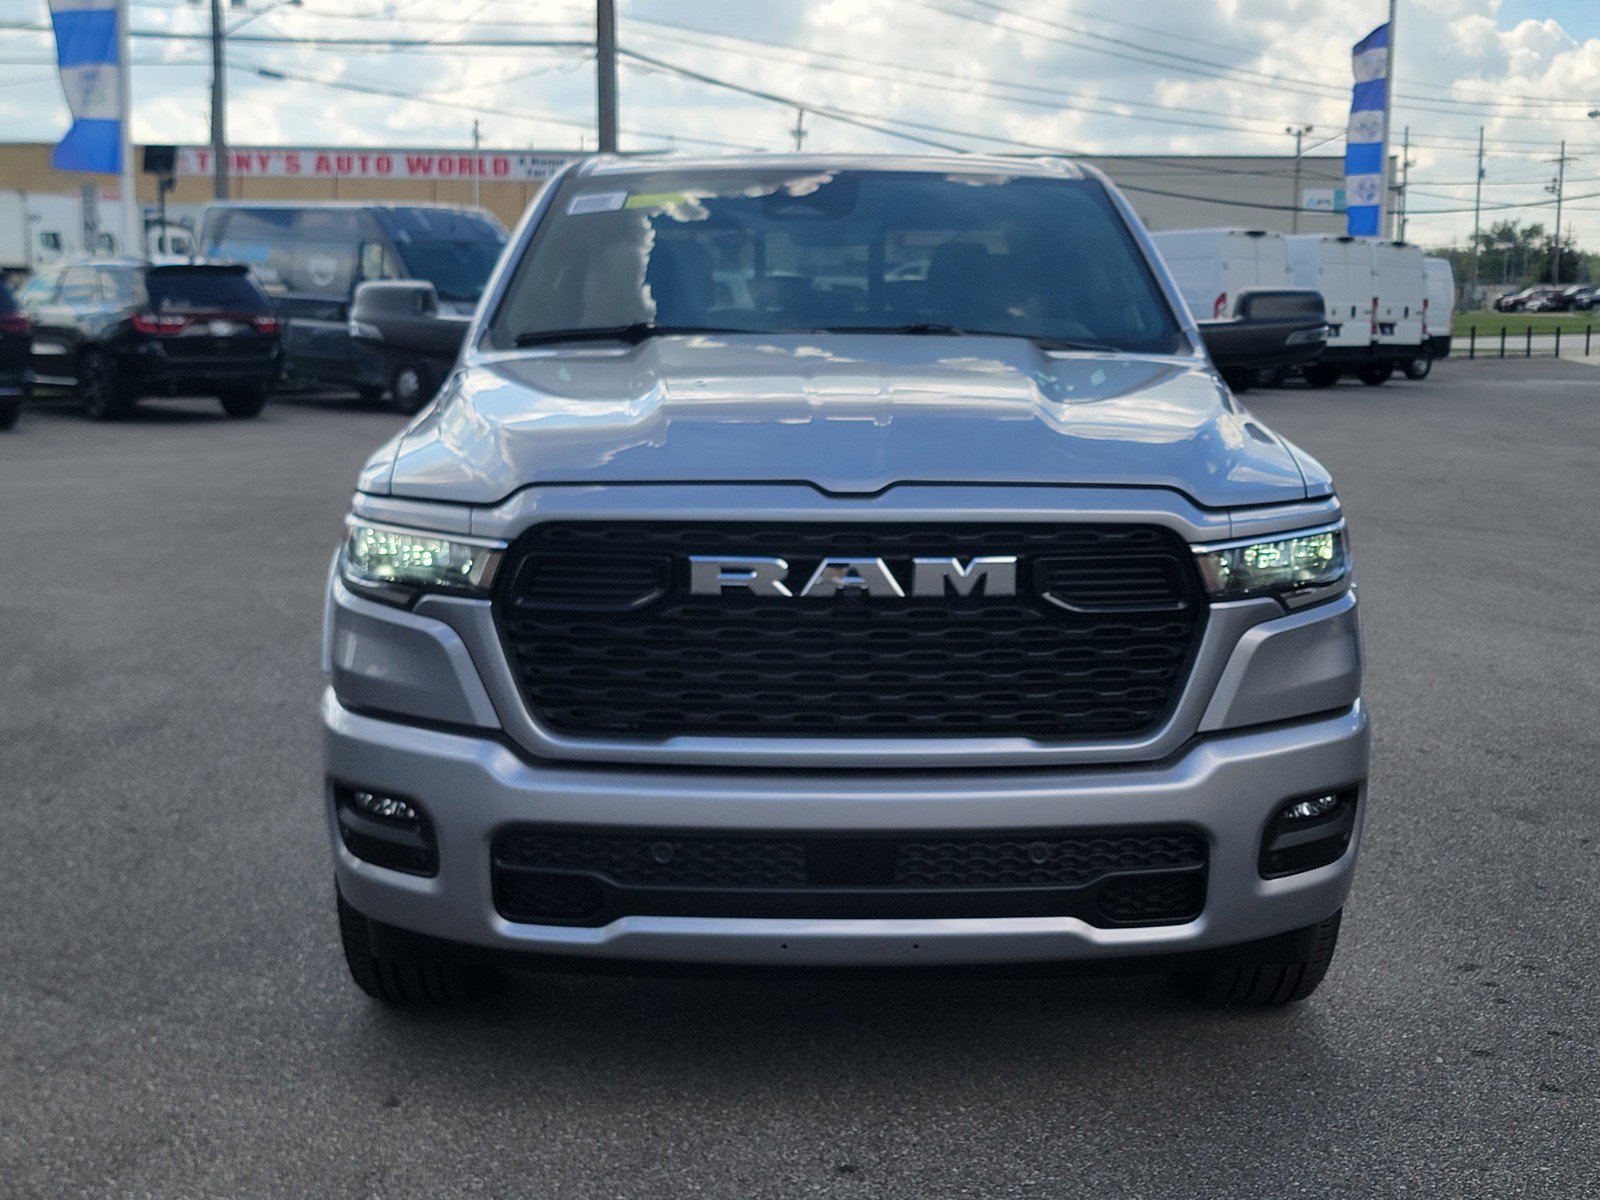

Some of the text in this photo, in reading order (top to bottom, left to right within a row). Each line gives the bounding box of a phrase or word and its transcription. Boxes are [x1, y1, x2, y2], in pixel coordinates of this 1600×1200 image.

[315, 155, 392, 175] AUTO
[405, 156, 511, 177] WORLD
[688, 556, 1018, 597] RAM
